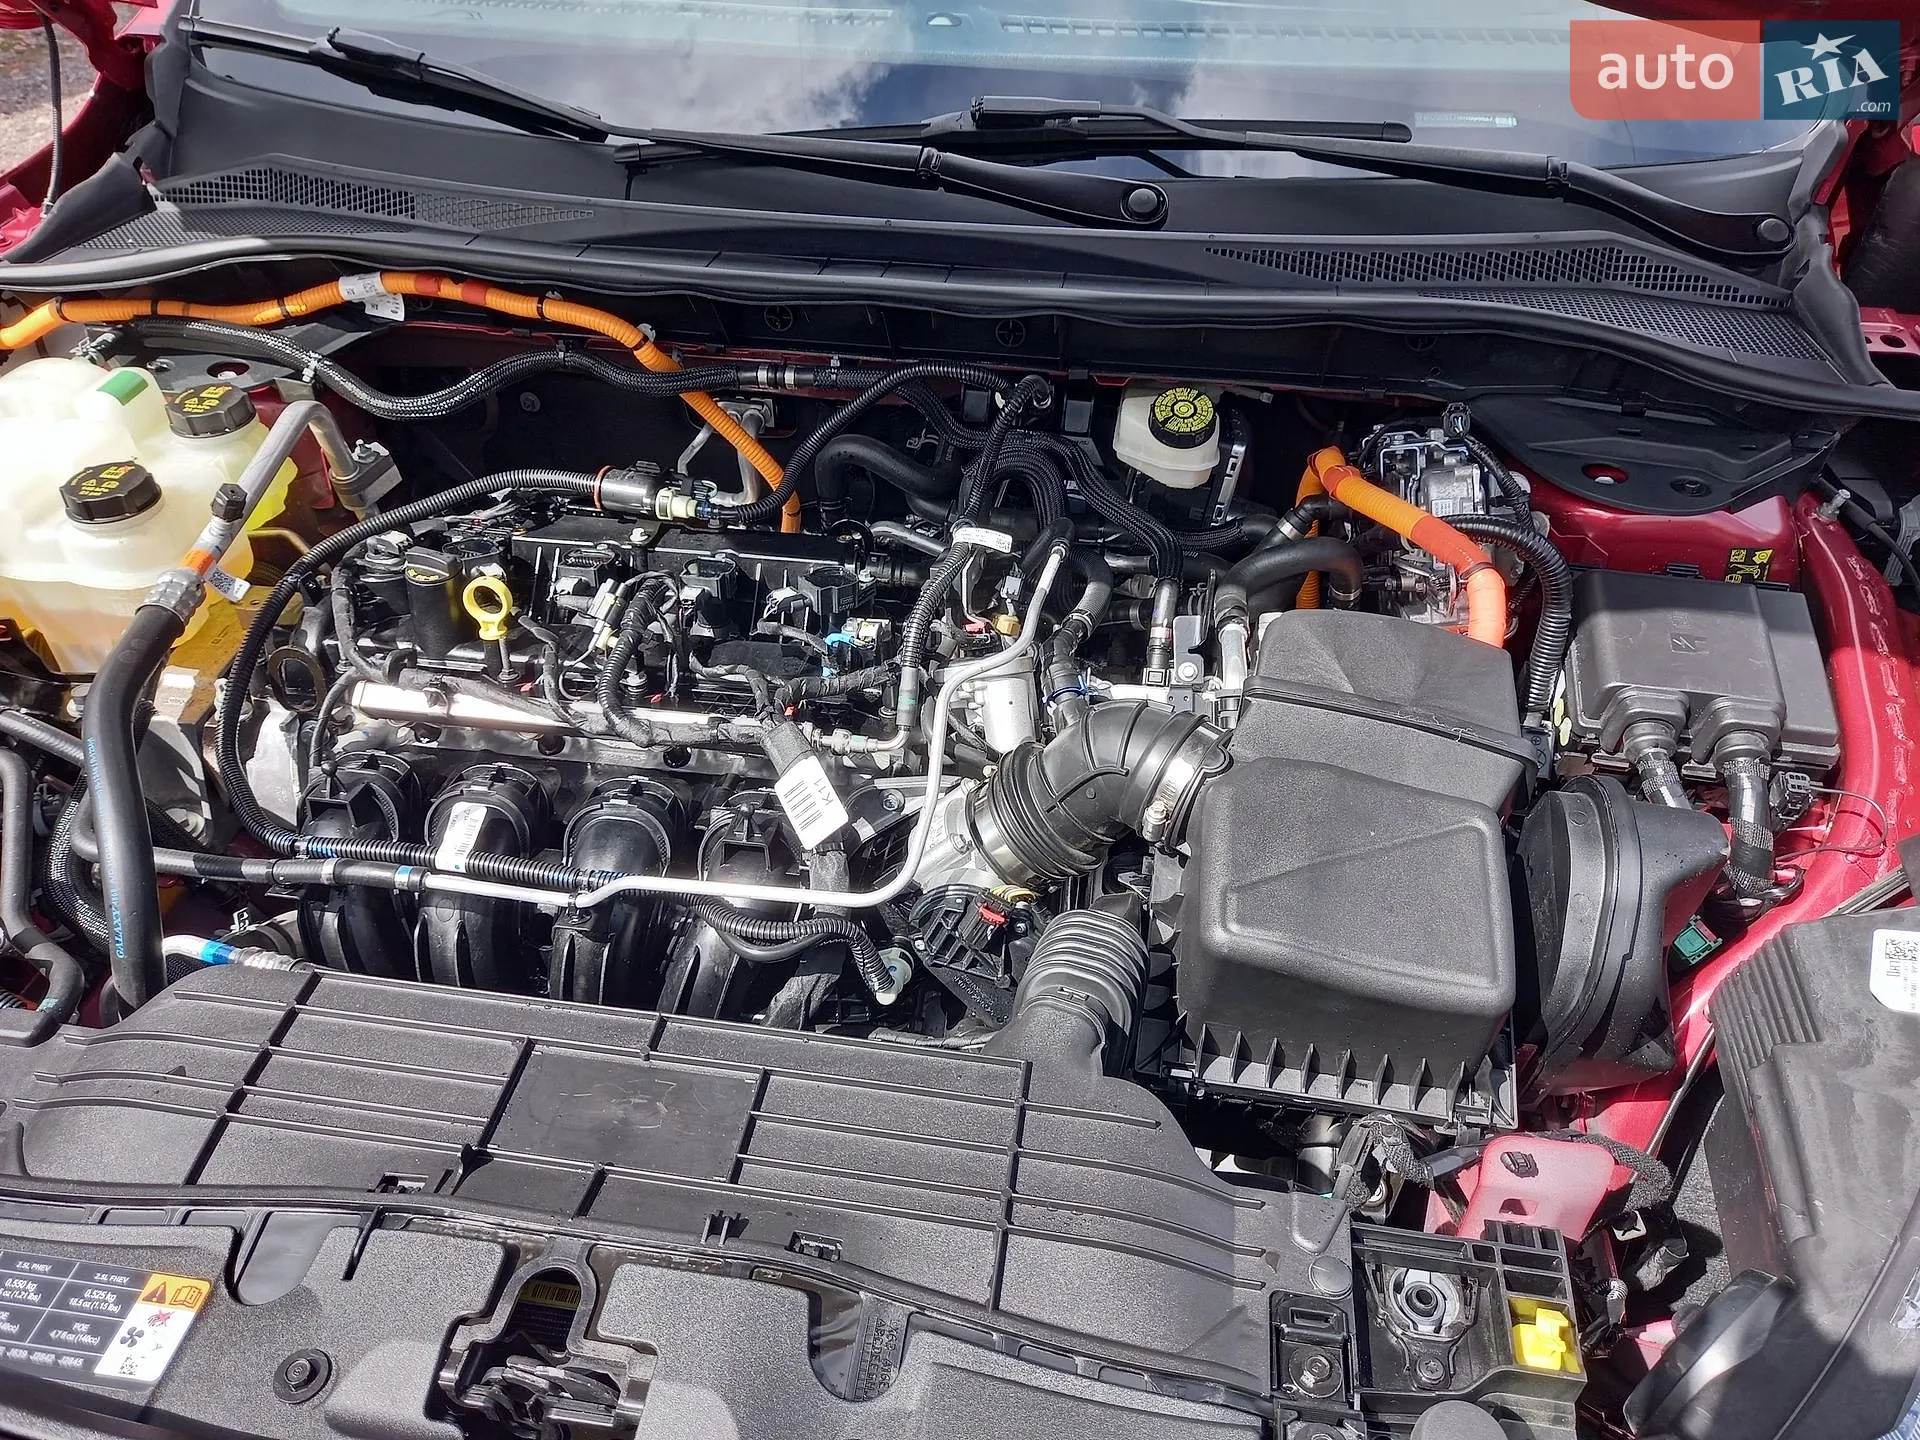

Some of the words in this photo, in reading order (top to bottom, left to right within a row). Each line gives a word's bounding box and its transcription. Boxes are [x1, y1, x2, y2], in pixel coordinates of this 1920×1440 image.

[30, 1263, 52, 1273] PHEV
[94, 1272, 108, 1281] 2.5L
[5, 1278, 27, 1290] 0.550
[26, 1280, 38, 1293] kg
[84, 1288, 107, 1299] 0.525
[106, 1291, 117, 1303] kg
